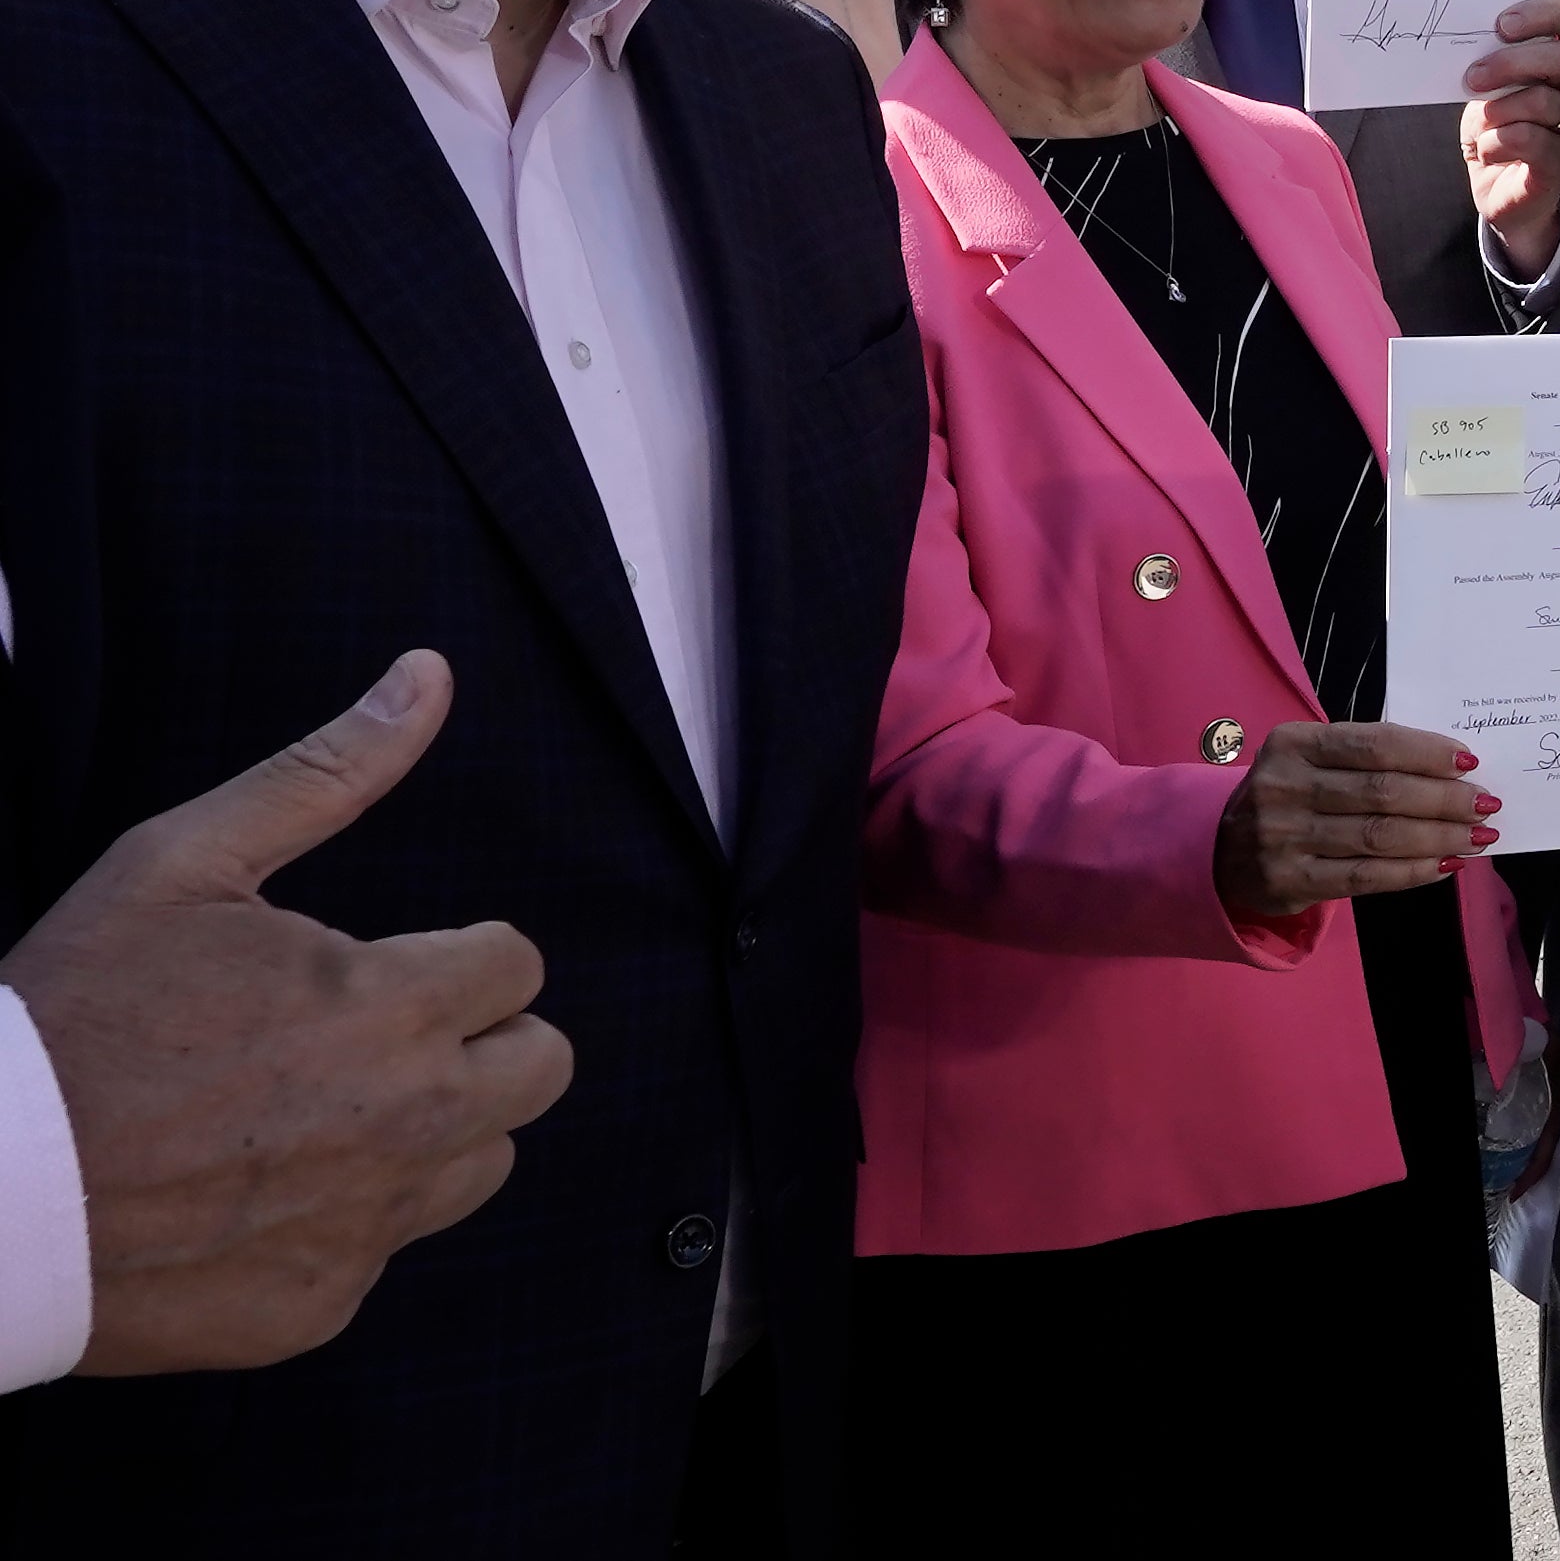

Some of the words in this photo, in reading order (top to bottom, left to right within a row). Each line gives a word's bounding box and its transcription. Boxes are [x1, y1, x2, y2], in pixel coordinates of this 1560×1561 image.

[1530, 391, 1558, 400] Senate
[1431, 420, 1450, 435] SB
[1459, 416, 1488, 431] 905
[1528, 450, 1556, 459] August
[1454, 574, 1481, 584] Passed
[1482, 573, 1494, 582] the
[1496, 572, 1535, 582] Assembly
[1462, 699, 1479, 707] This
[1481, 697, 1495, 706] bill
[1514, 693, 1546, 704] received
[1547, 693, 1557, 703] by
[1451, 721, 1461, 730] of
[1465, 709, 1532, 734] September
